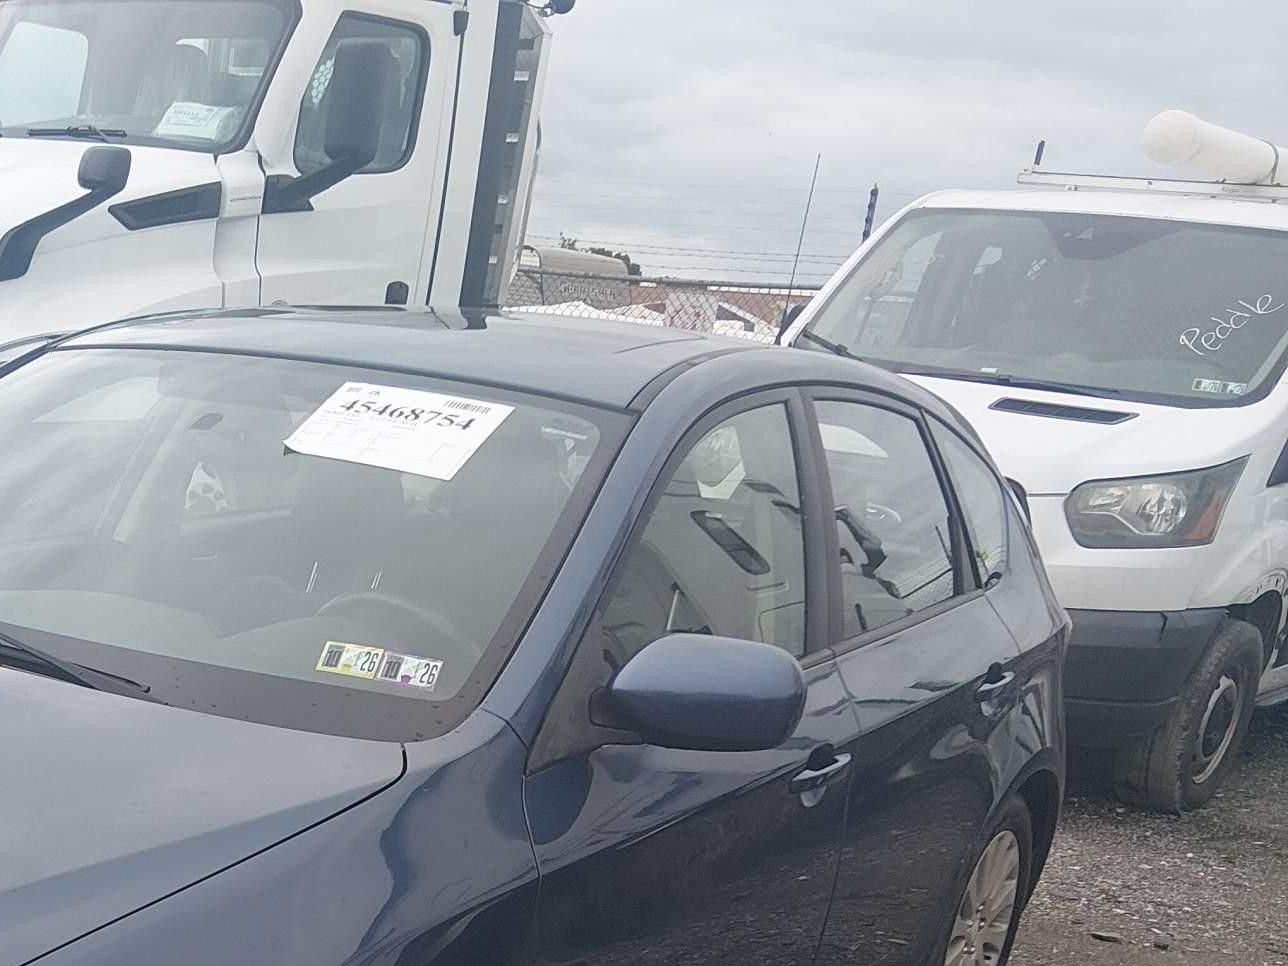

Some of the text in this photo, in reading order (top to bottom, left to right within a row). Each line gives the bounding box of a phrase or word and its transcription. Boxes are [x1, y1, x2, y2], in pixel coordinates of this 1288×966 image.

[1179, 294, 1286, 356] Peddle
[339, 399, 476, 431] 45468754
[360, 651, 379, 673] 26
[419, 663, 439, 685] 26
